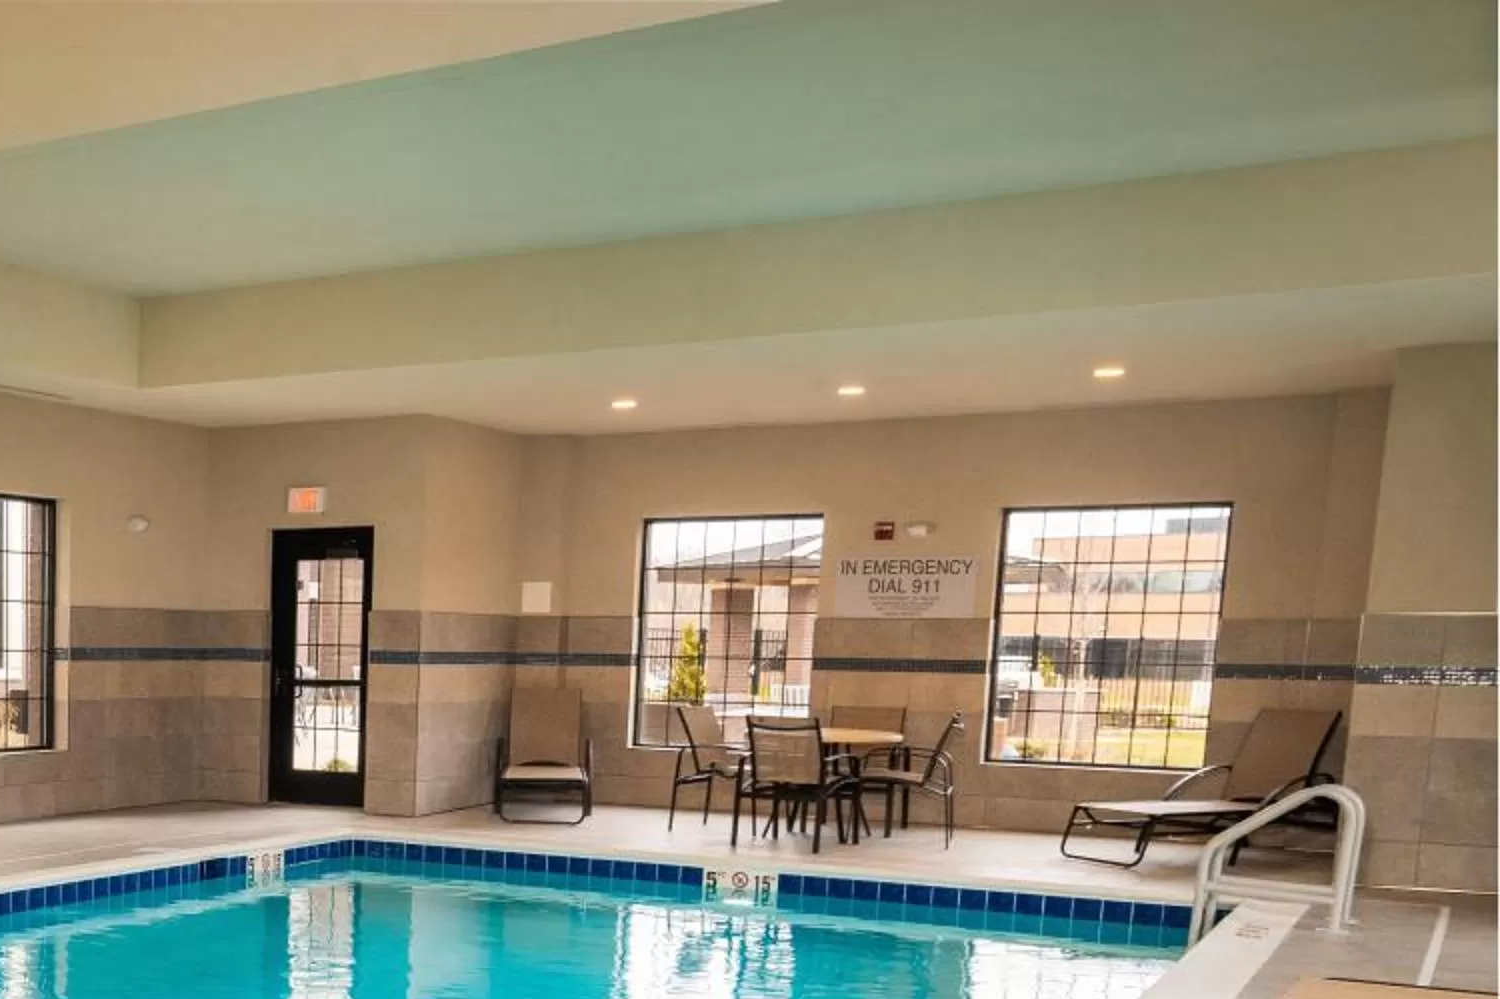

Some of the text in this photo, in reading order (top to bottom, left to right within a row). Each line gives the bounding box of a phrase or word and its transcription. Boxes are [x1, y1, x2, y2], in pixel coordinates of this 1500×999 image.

[840, 559, 973, 575] IN EMERGENCY
[868, 578, 940, 593] DIAL 911
